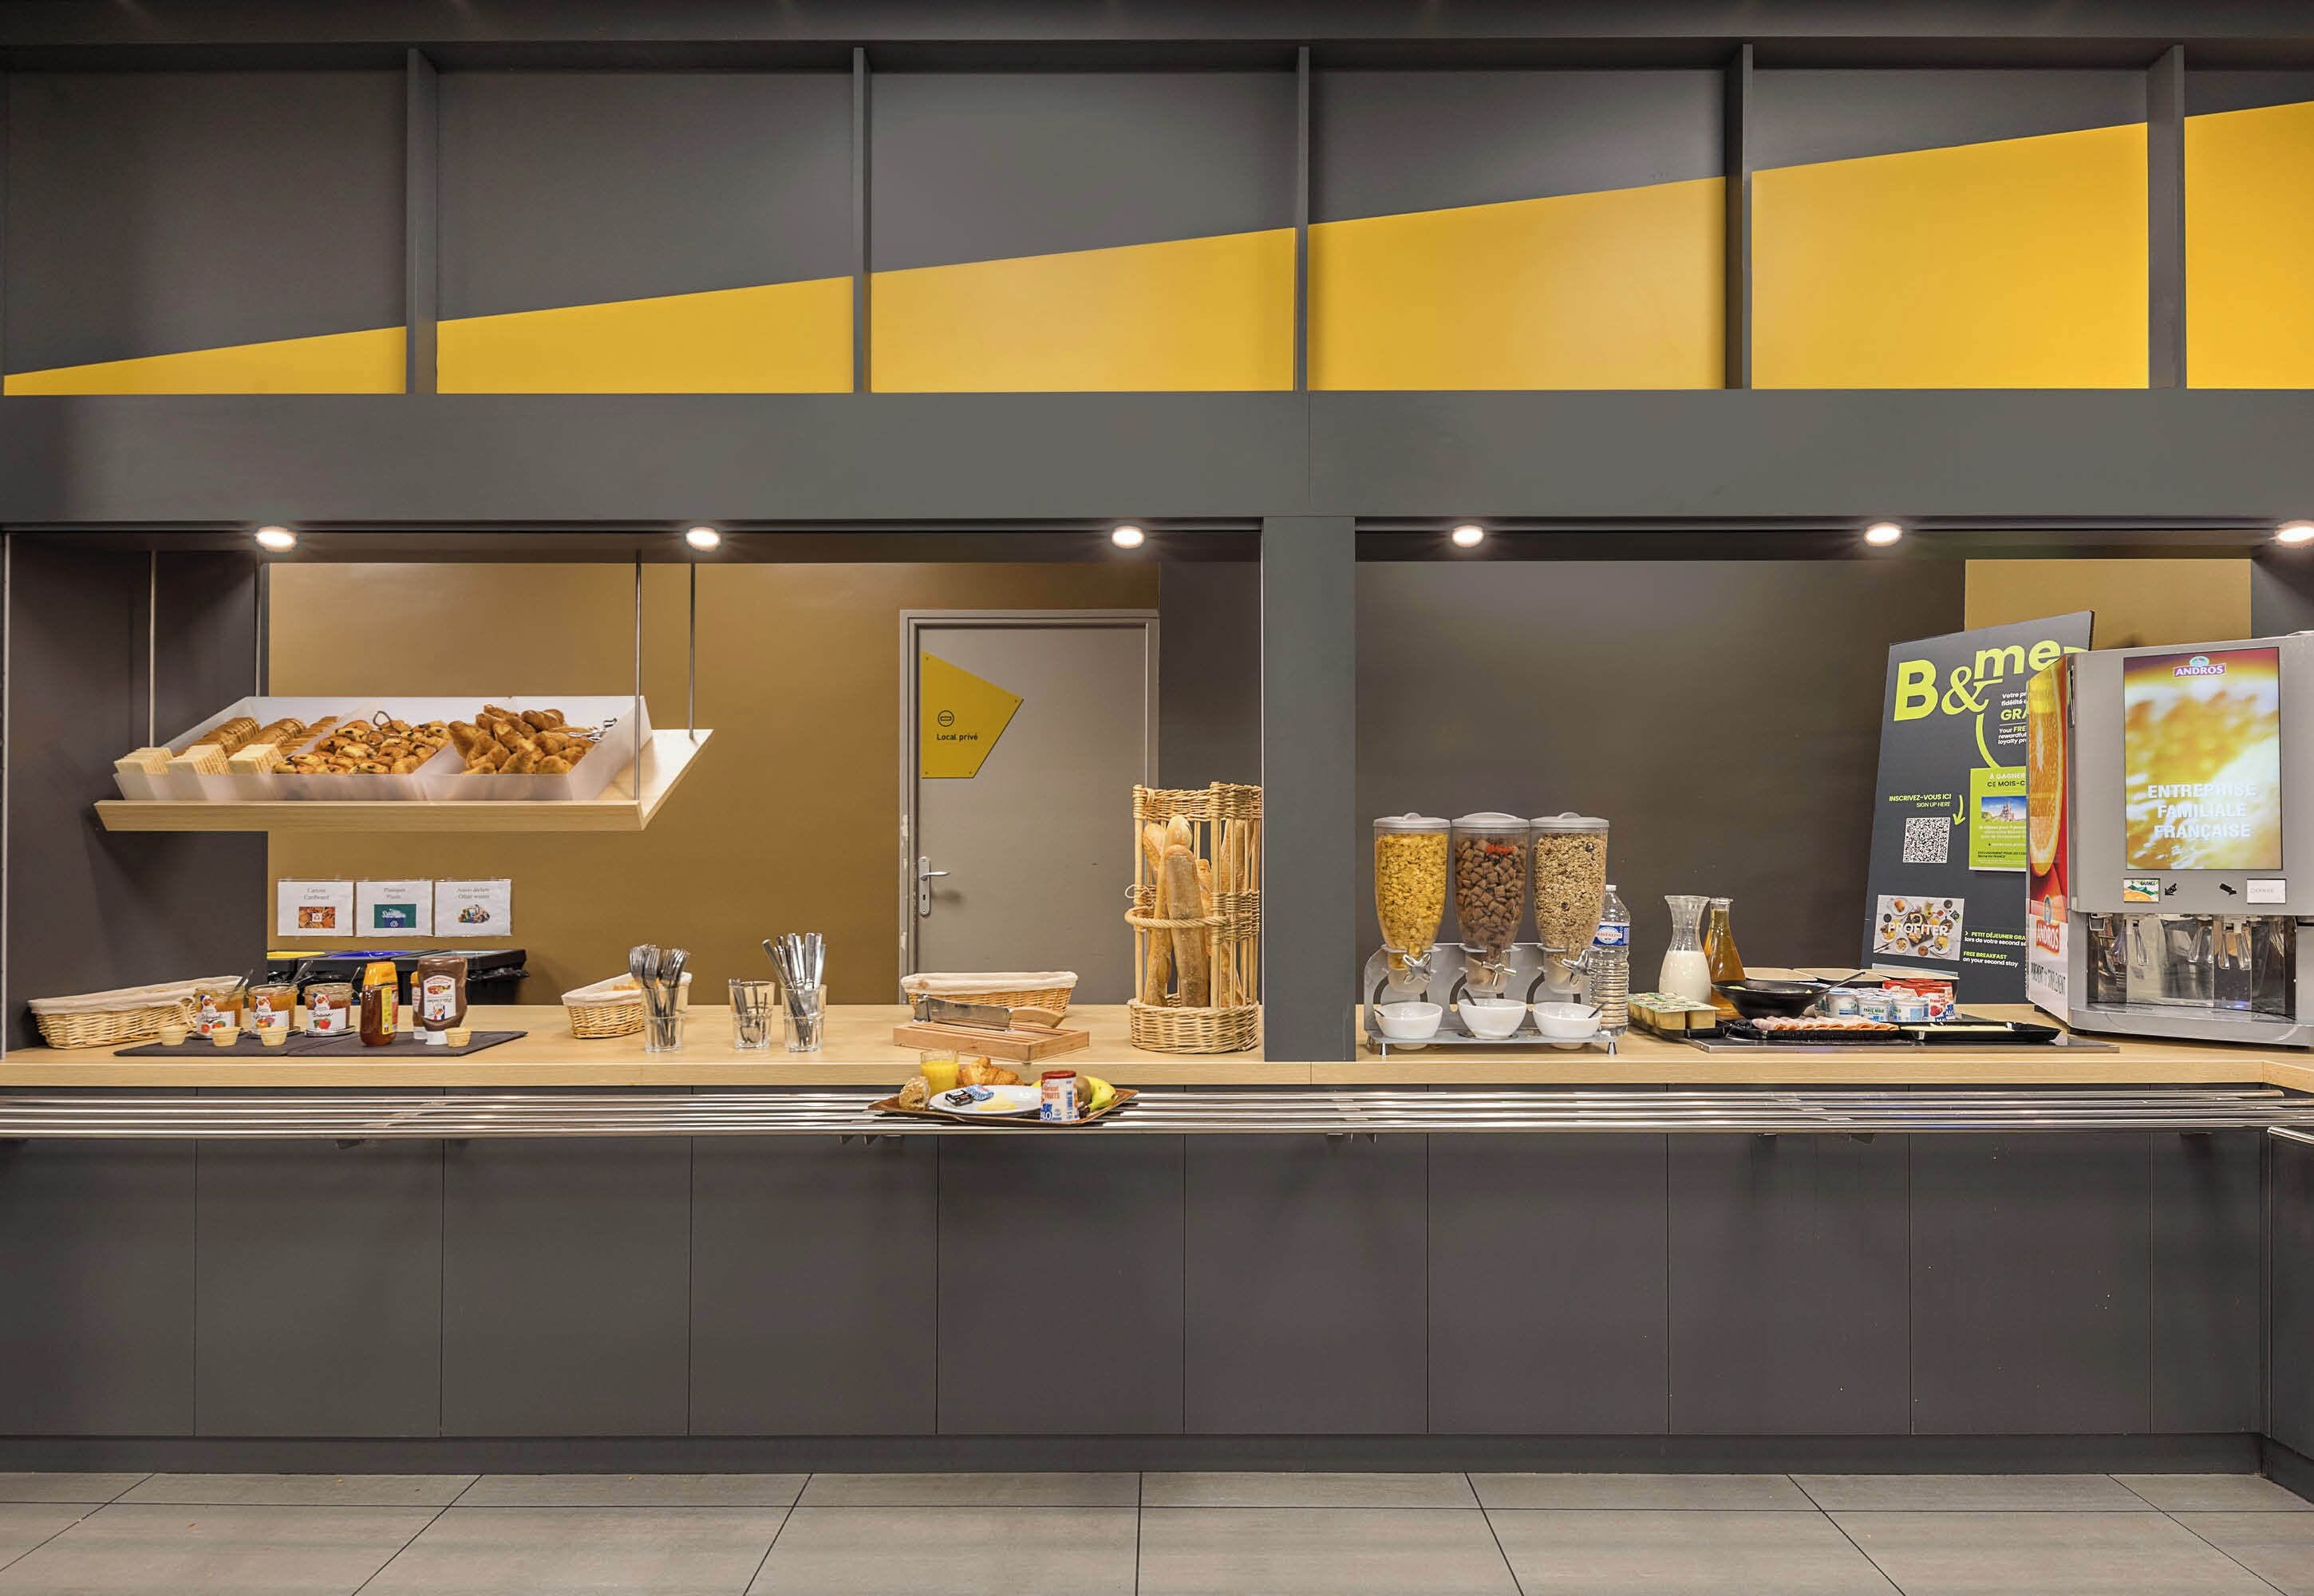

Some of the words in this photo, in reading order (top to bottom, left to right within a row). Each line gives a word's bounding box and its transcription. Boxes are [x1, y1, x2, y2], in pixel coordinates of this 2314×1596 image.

[2175, 666, 2223, 676] ANDROS
[959, 733, 978, 743] privé
[1889, 793, 1941, 802] INSCRIVEZ-VOUS
[2146, 783, 2257, 799] ENTREPRISE
[2157, 803, 2248, 819] FAMILIALE
[2154, 823, 2252, 841] FRANÇAISE
[2036, 923, 2059, 950] ANDROS
